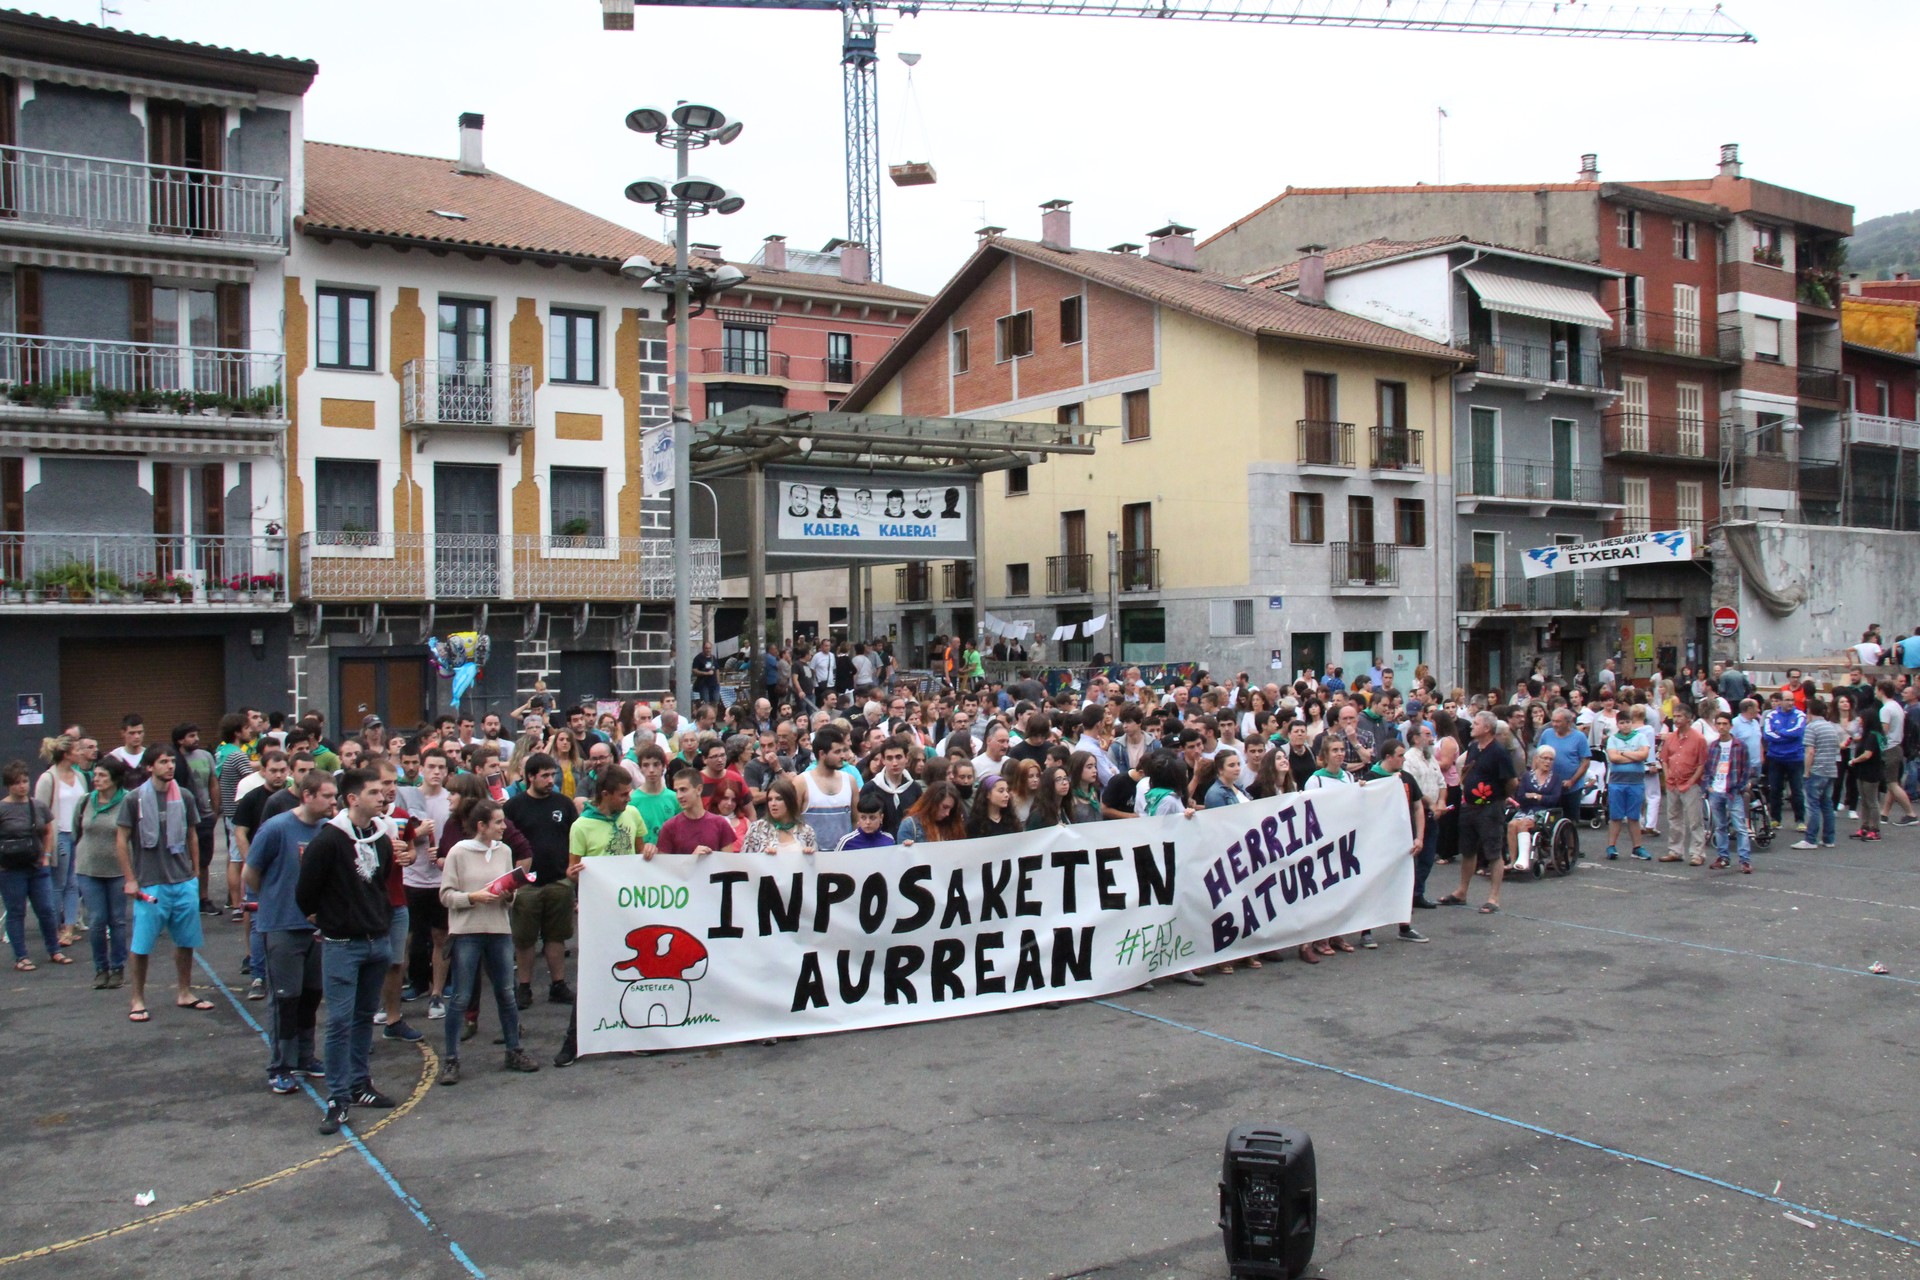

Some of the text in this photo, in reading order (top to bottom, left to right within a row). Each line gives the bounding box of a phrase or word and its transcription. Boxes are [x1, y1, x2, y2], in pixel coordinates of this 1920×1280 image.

[803, 523, 937, 538] KALERA KALERA!
[1560, 544, 1585, 552] PRESO
[1601, 533, 1648, 547] IHESLARIAK
[1568, 546, 1640, 565] ETXERA!
[1203, 799, 1324, 910] HERRIA
[618, 884, 690, 910] ONDDO
[707, 841, 1176, 939] INPOSAKETEN
[1211, 829, 1361, 954] BATURIK
[1115, 917, 1177, 966] #EAJ
[790, 925, 1096, 1013] AURREAN
